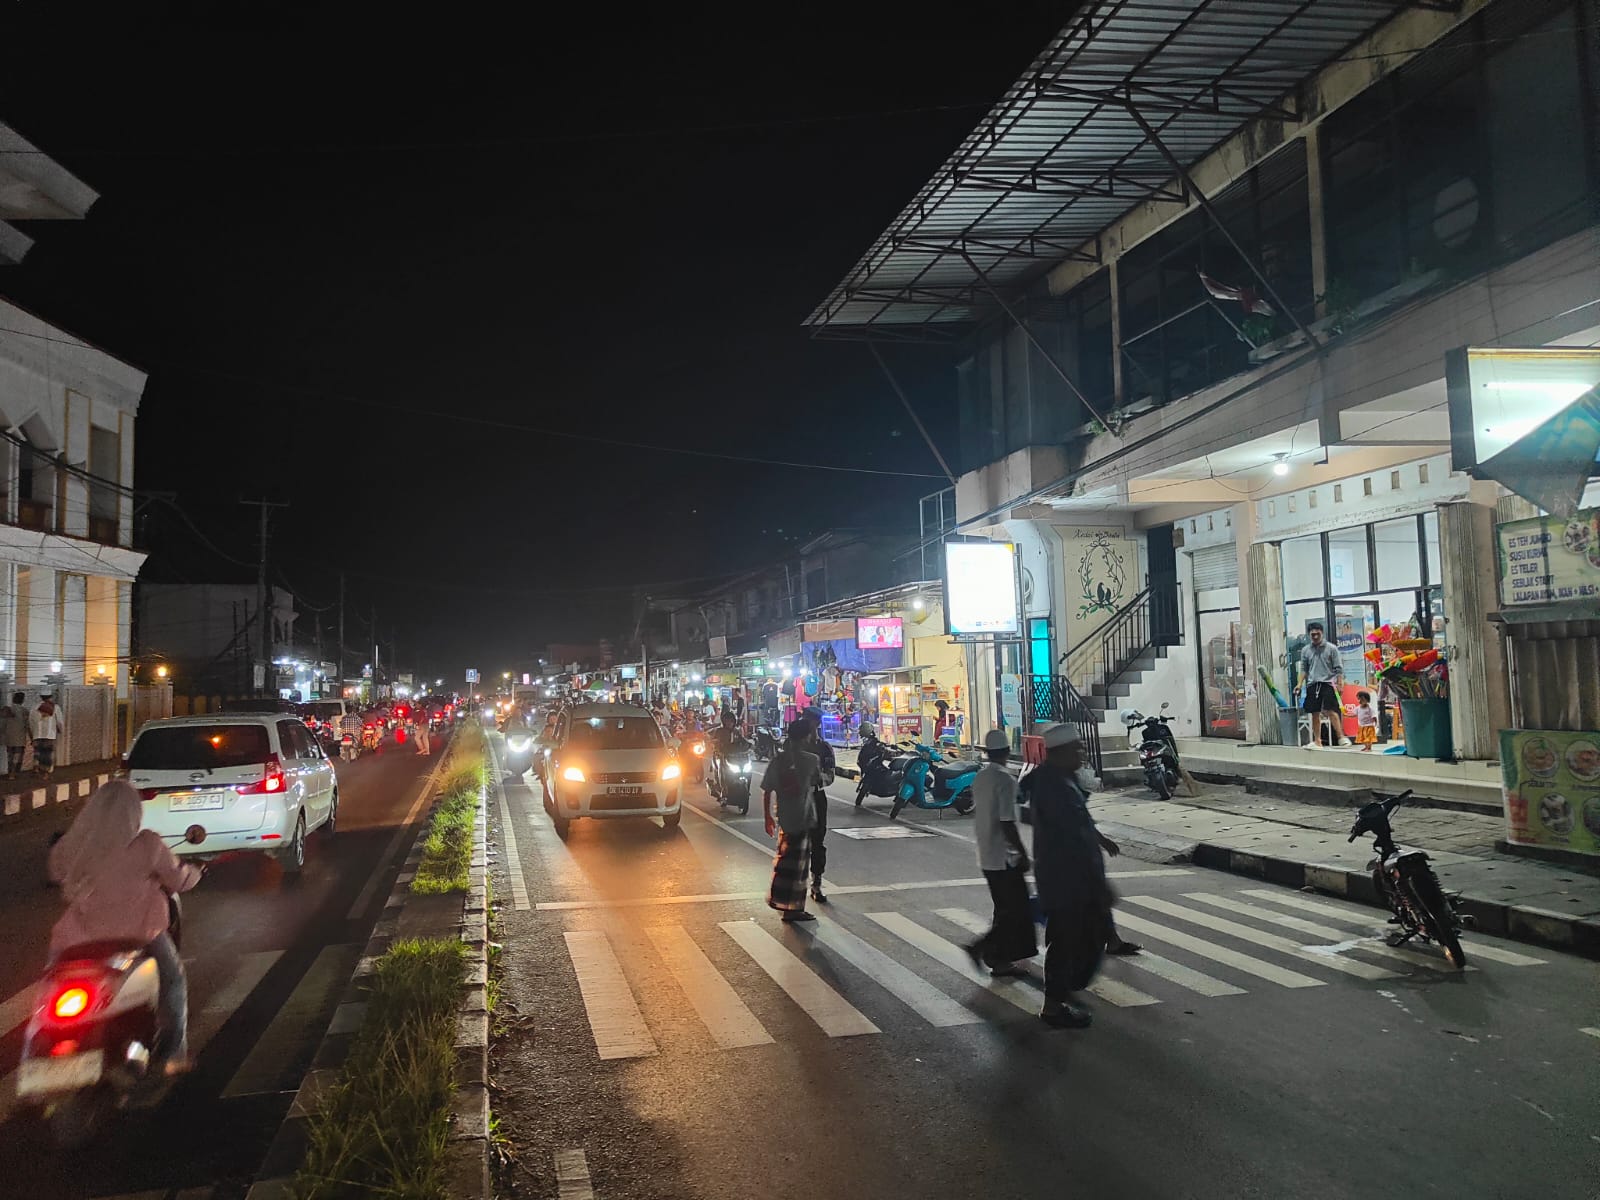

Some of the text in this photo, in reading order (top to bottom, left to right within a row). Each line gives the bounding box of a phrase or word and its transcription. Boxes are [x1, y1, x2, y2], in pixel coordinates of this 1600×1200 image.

[1509, 538, 1516, 548] ES
[1517, 536, 1528, 547] TEH
[1510, 551, 1526, 561] SUSU
[1511, 563, 1538, 574] ES TELER
[1512, 577, 1534, 588] SEBLAK
[1513, 591, 1539, 601] LALAPAN
